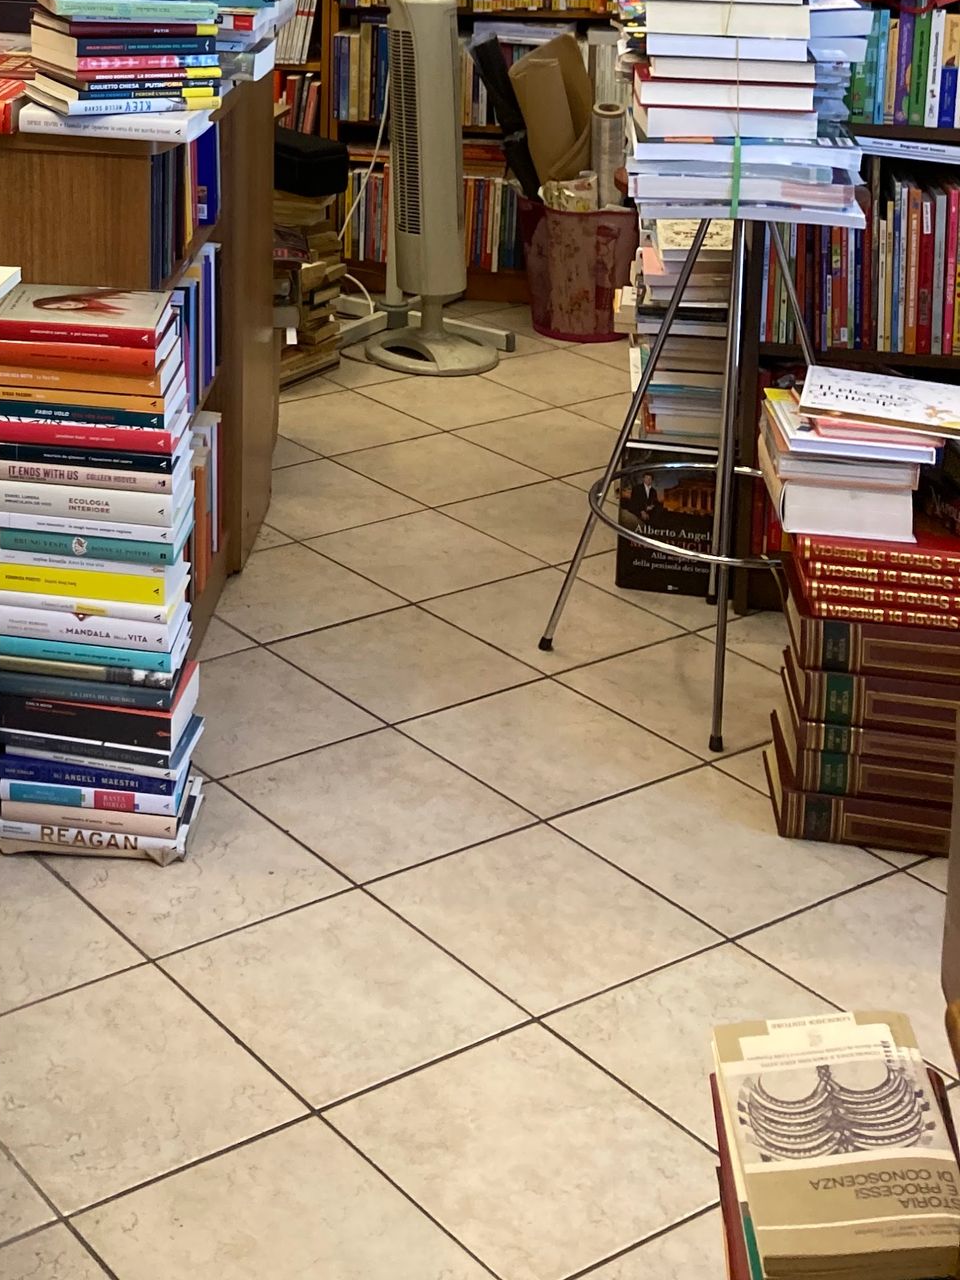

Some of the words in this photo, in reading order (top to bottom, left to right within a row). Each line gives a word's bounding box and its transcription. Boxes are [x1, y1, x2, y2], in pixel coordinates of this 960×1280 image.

[124, 101, 152, 112] KIEV
[54, 410, 70, 418] VOLO
[8, 465, 17, 475] IT
[18, 466, 41, 478] ENDS
[43, 468, 65, 480] WITH
[66, 470, 79, 481] US
[68, 498, 110, 507] ECOLOGIA
[68, 505, 111, 514] INTERIORE
[634, 523, 677, 538] Alberto
[813, 543, 868, 562] BRESCIA
[822, 564, 879, 582] BRESCIA
[819, 583, 875, 602] BRESCIA
[828, 604, 884, 623] BRESCIA
[66, 628, 111, 639] MANDALA
[127, 634, 148, 643] VITA
[65, 774, 96, 783] ANGELI
[101, 777, 139, 788] MAESTRI
[40, 825, 138, 850] REAGAN
[809, 1168, 932, 1191] CONOSCENZA
[936, 1170, 954, 1183] DI
[855, 1182, 941, 1199] PROCESSI
[948, 1184, 958, 1196] E
